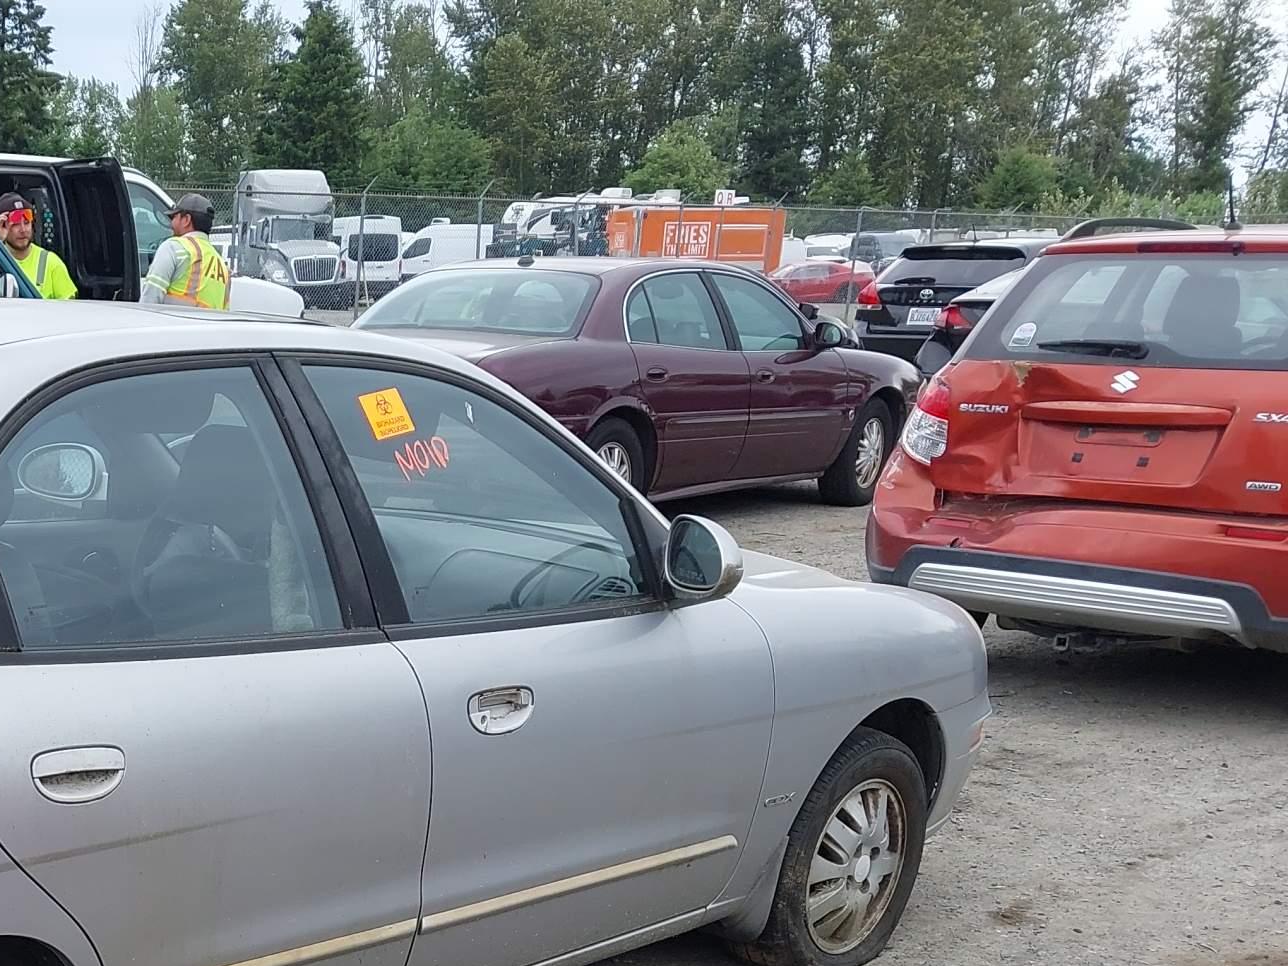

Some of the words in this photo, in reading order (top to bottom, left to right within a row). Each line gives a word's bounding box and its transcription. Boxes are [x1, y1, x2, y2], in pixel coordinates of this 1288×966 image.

[666, 224, 708, 244] FRIES
[683, 244, 707, 256] LIMIT
[959, 402, 1009, 414] SUZUKI
[1246, 482, 1280, 491] AWD
